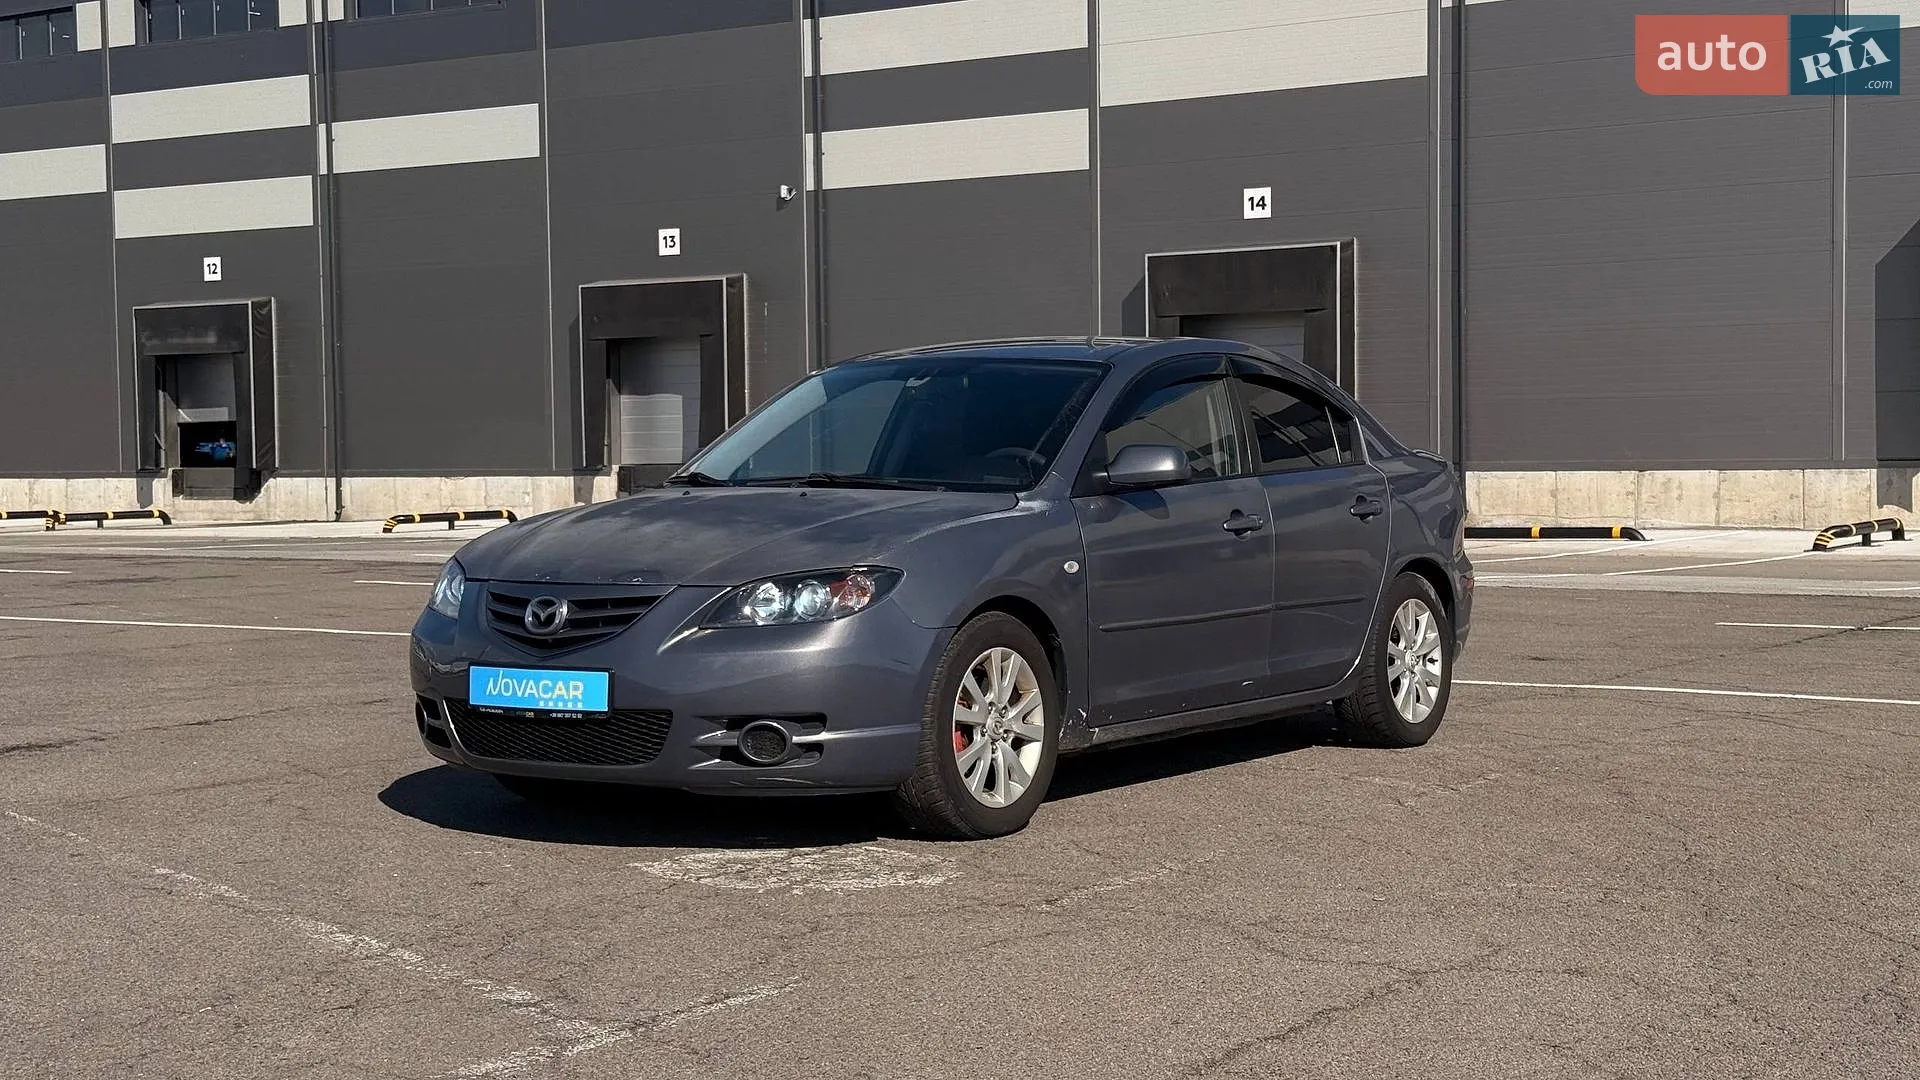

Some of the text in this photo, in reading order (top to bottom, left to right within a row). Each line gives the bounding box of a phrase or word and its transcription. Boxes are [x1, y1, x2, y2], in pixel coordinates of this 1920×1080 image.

[1248, 195, 1267, 211] 14
[662, 235, 676, 248] 13
[206, 262, 218, 274] 12
[486, 670, 584, 700] NOVACAR
